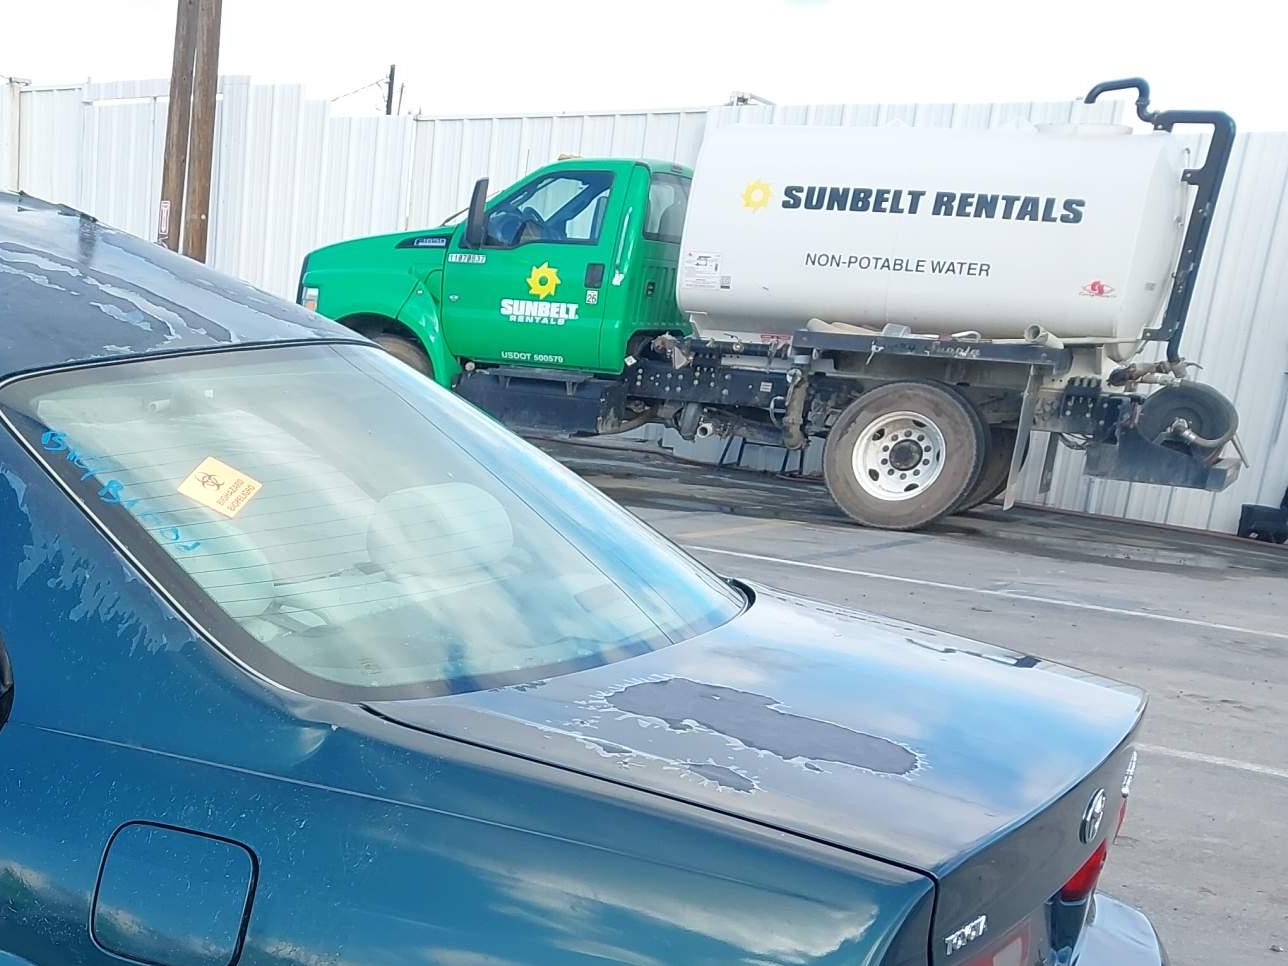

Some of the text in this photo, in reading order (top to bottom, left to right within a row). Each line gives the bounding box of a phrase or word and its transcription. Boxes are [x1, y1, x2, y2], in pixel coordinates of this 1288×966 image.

[781, 185, 1086, 224] SUNBELT RENTALS
[805, 253, 991, 277] NON-POTABLE WATER
[500, 299, 579, 319] SUNBELT
[509, 315, 565, 325] RENTALS
[501, 351, 531, 361] USDOT
